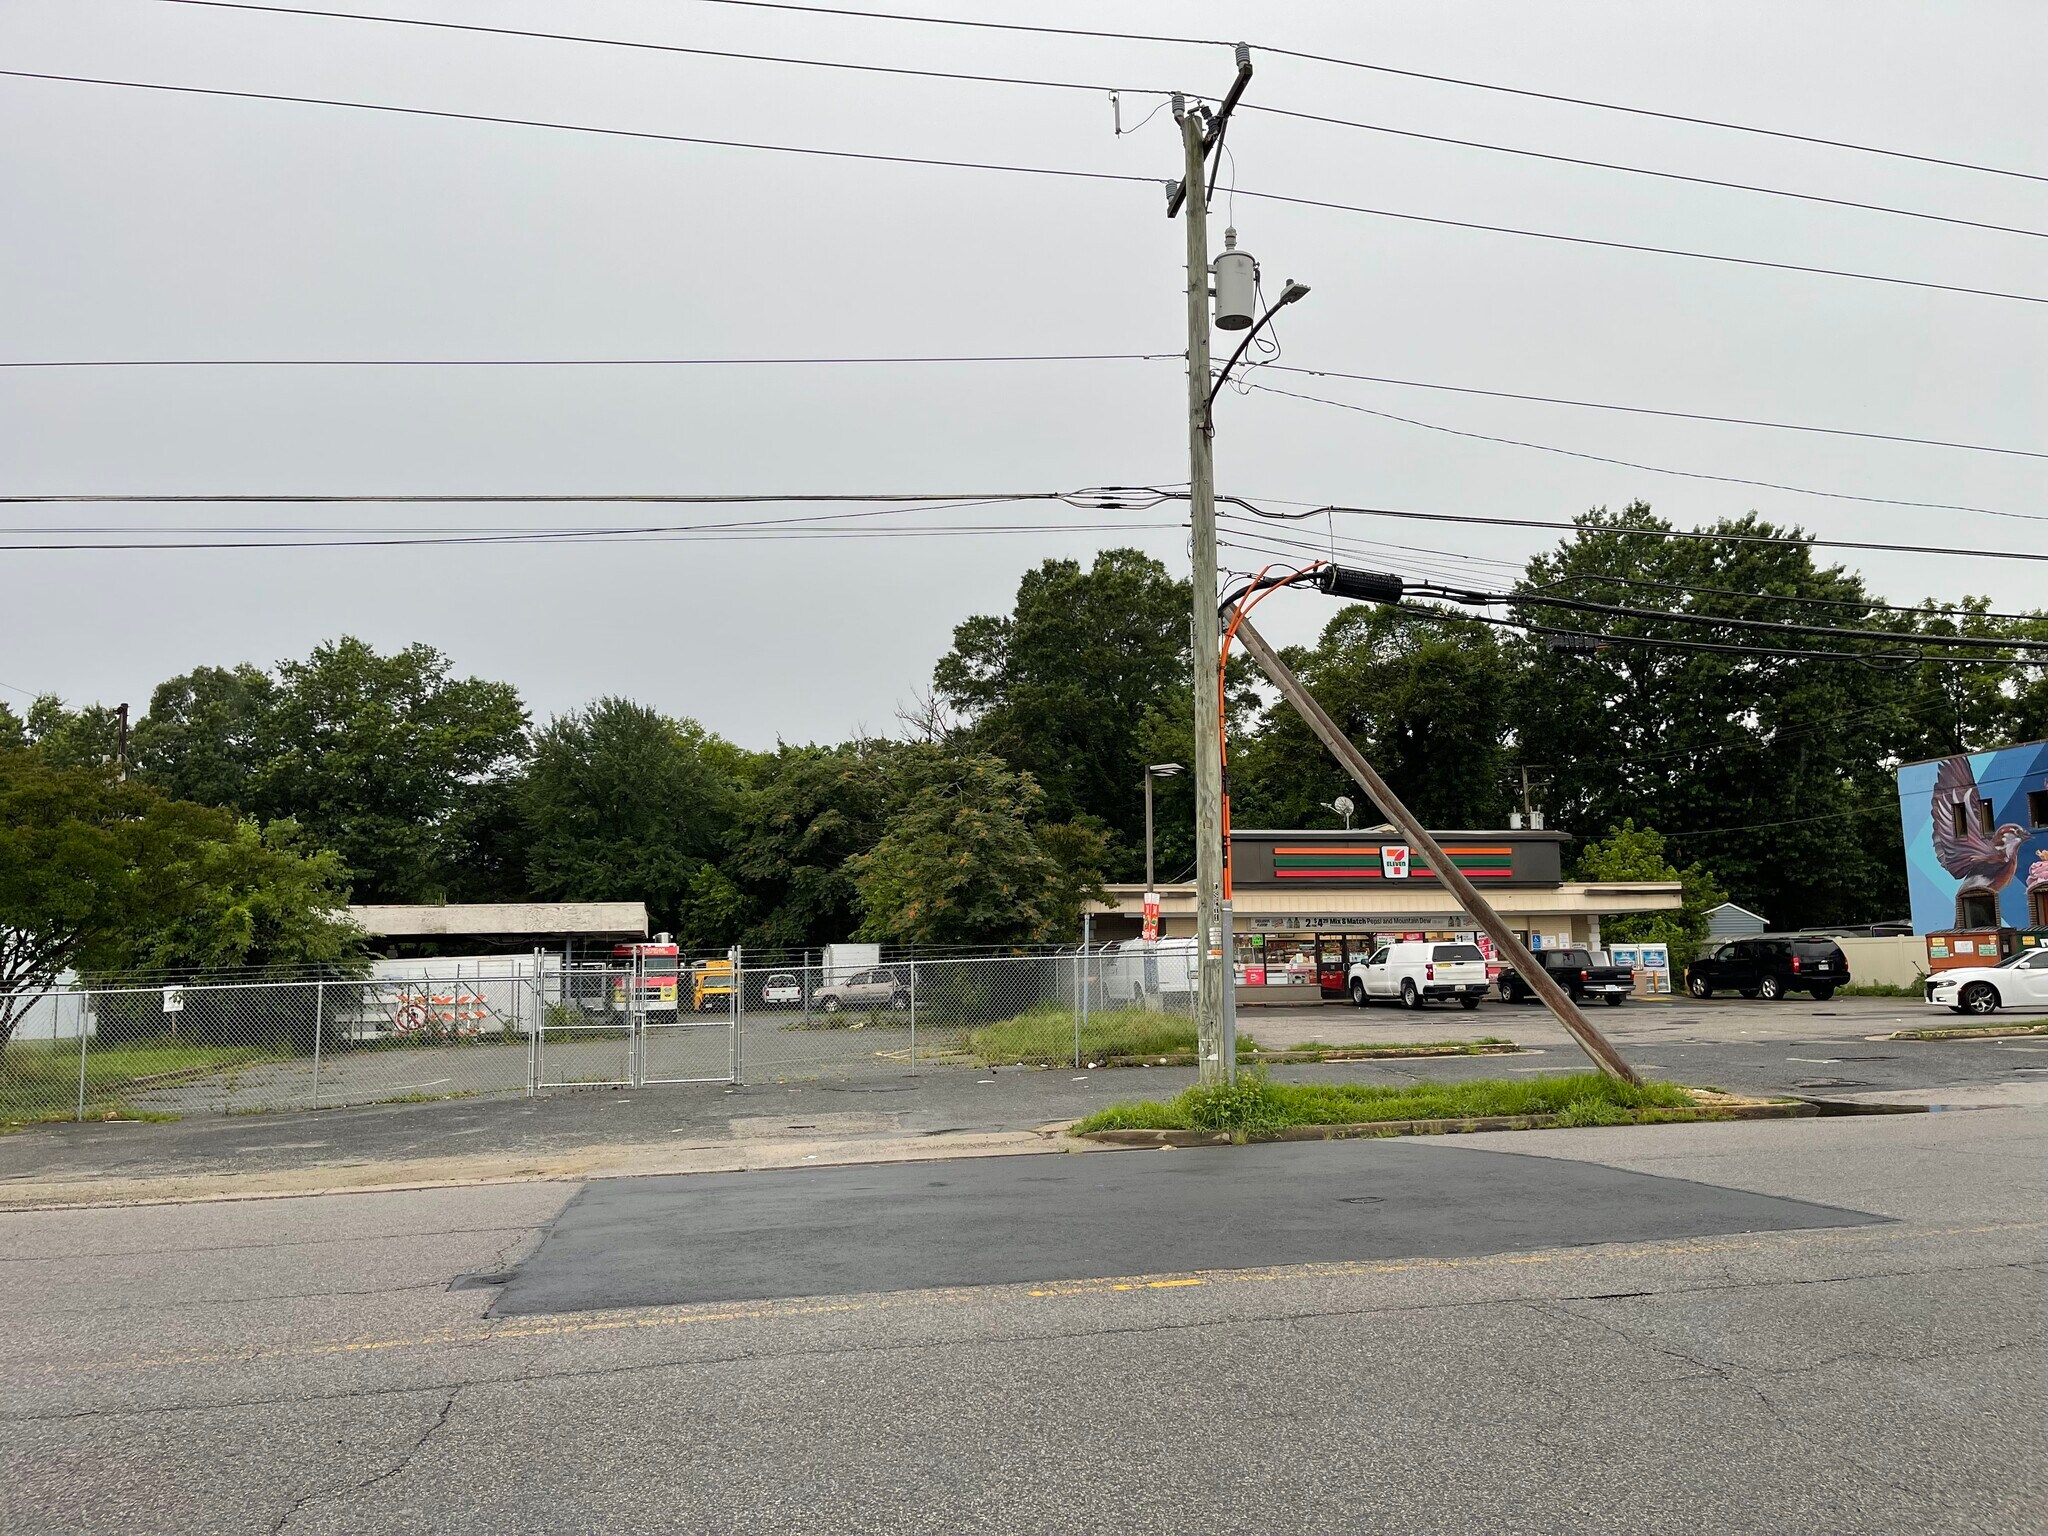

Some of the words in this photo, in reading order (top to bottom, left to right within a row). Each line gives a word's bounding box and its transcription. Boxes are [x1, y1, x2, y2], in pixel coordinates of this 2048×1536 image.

[1387, 849, 1405, 875] 7
[1305, 918, 1311, 927] 2
[1367, 917, 1381, 925] Pepsi
